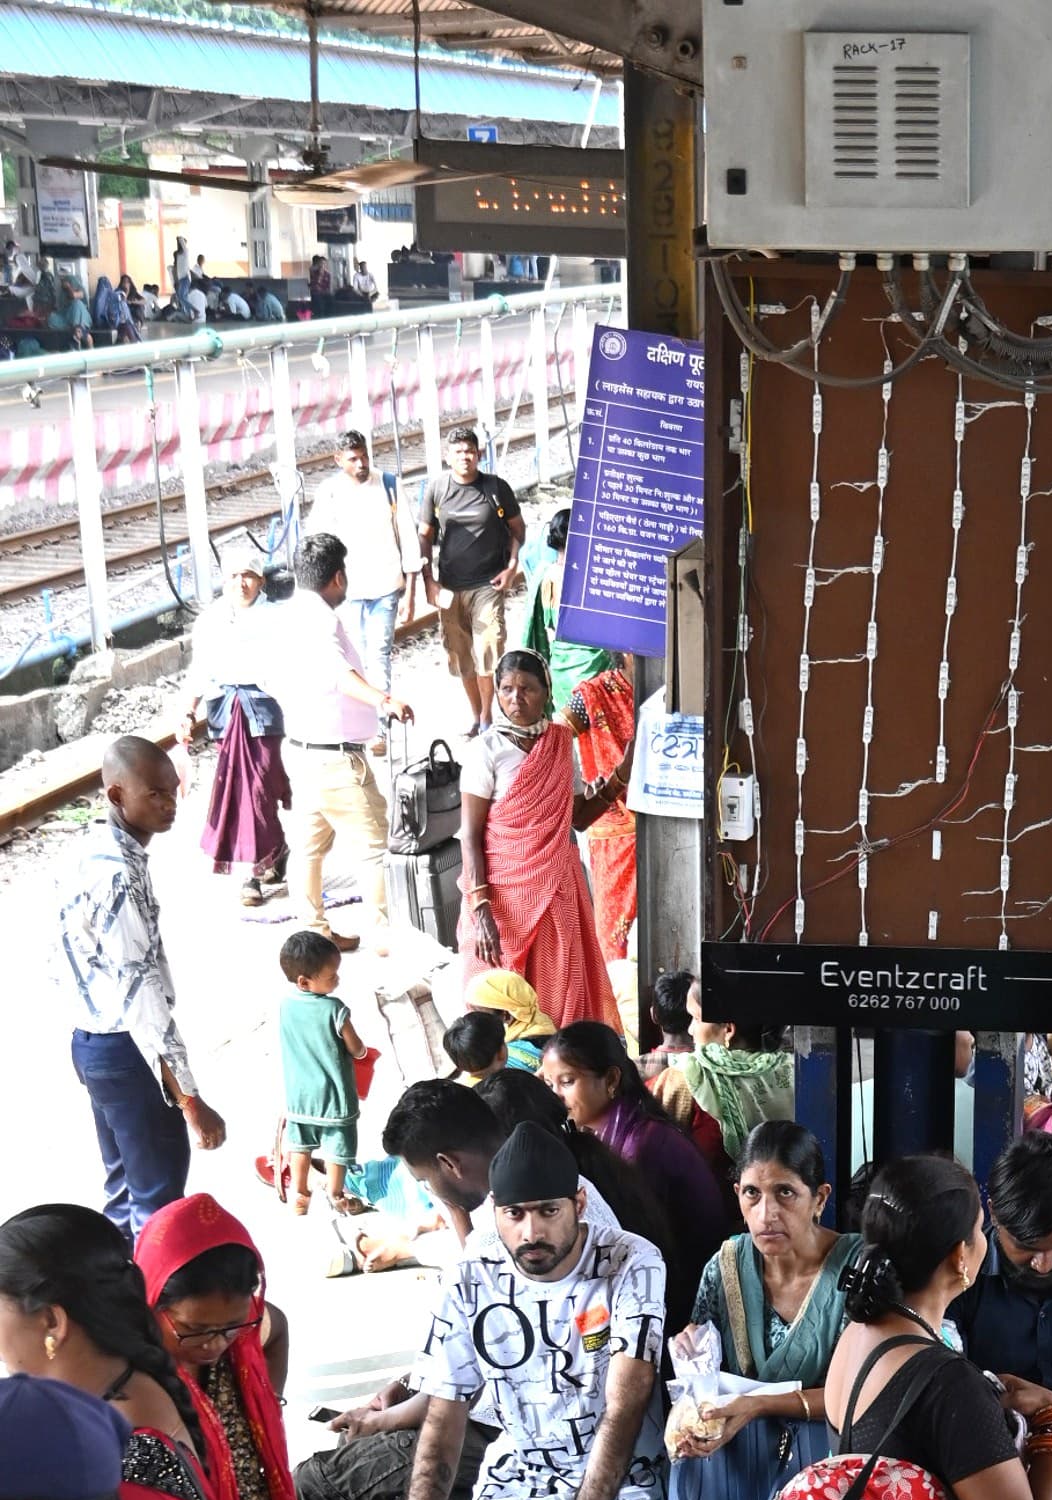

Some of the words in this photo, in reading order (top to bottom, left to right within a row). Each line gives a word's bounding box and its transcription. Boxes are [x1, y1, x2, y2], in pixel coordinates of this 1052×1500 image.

[843, 38, 906, 60] RACK-17
[646, 342, 686, 366] दक्षिण
[622, 438, 632, 446] 40
[820, 961, 988, 992] Eventzcraft
[848, 994, 890, 1008] 6262
[894, 996, 926, 1010] 767
[930, 996, 960, 1011] 000
